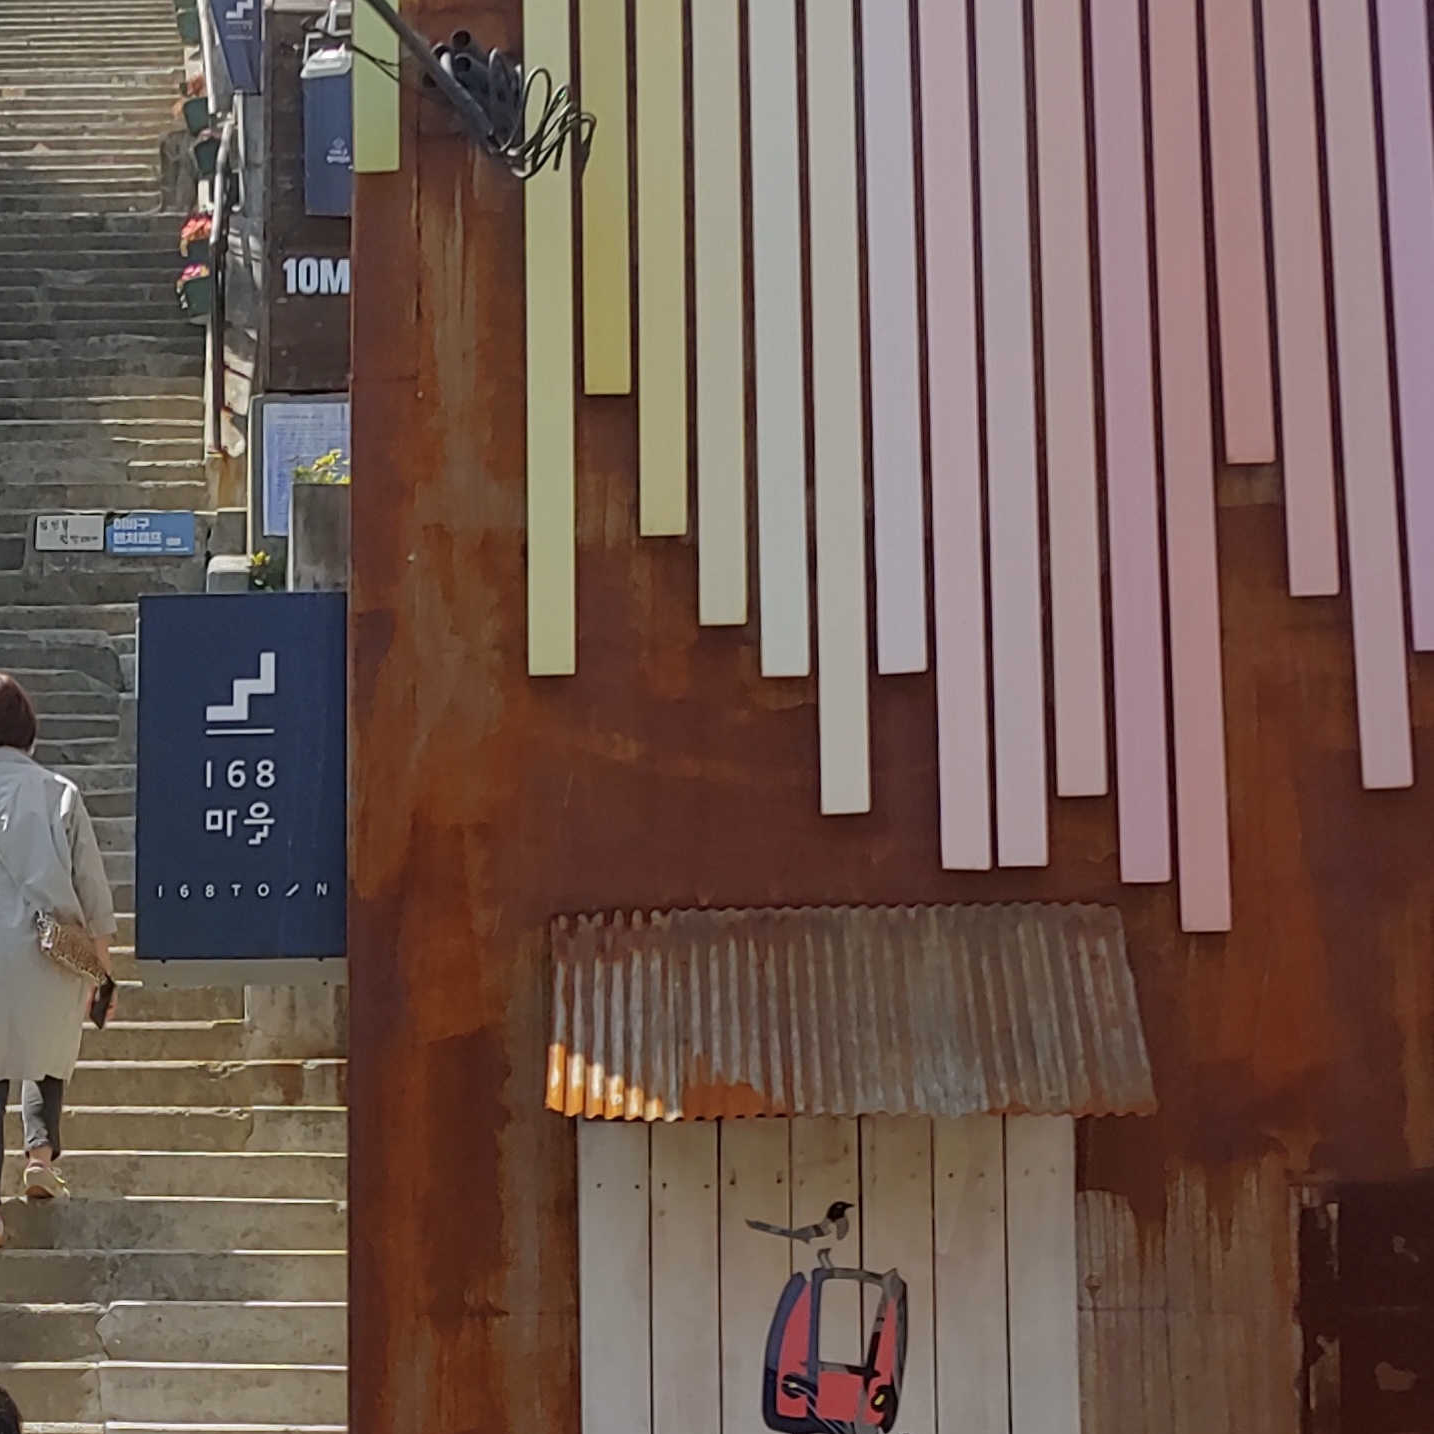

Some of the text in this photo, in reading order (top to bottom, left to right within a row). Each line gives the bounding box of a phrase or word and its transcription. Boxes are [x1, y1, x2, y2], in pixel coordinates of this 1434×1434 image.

[282, 257, 350, 295] 10M
[206, 759, 276, 789] 168
[206, 801, 276, 845] 마을
